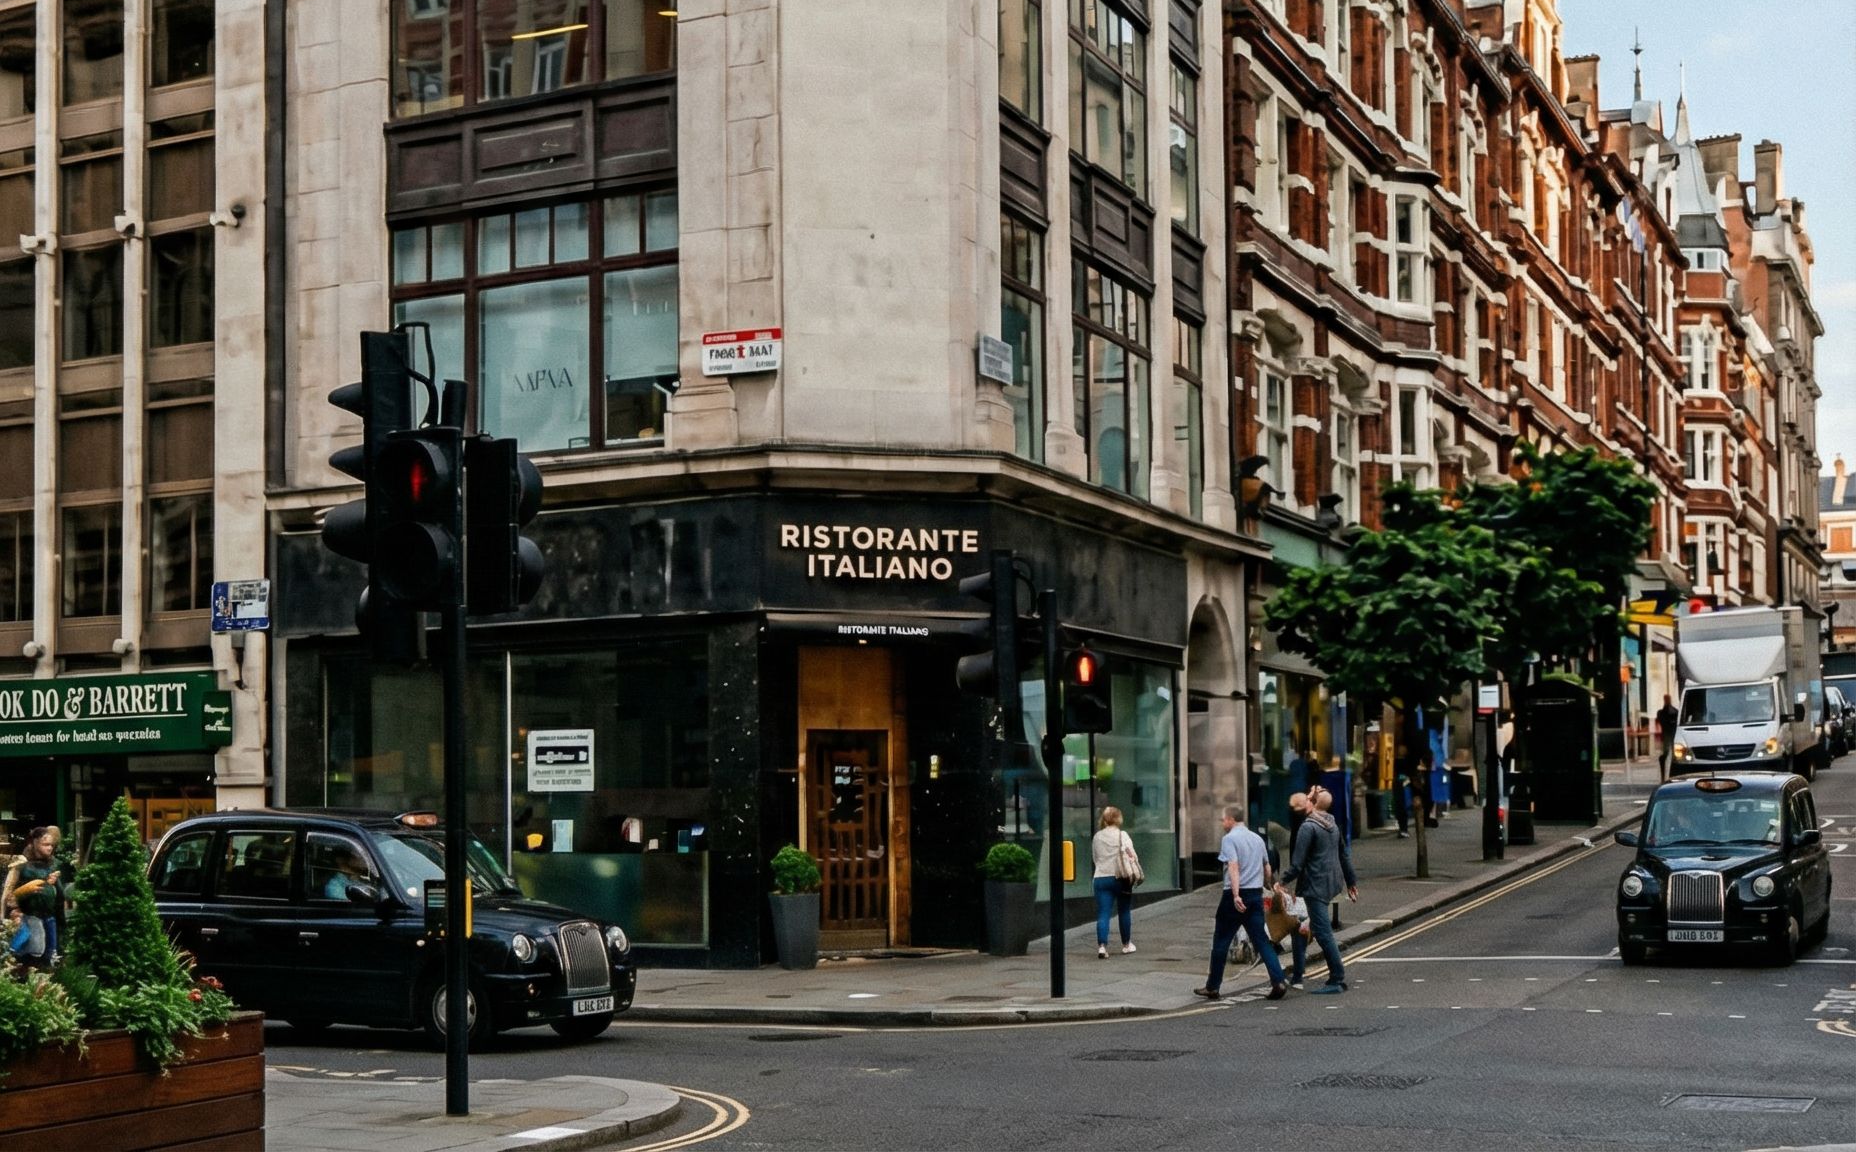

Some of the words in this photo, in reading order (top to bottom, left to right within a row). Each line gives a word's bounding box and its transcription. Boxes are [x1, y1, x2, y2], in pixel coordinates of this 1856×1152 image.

[781, 524, 978, 553] RISTORANTE
[808, 554, 953, 580] ITALIANO
[32, 688, 59, 717] DO
[64, 687, 84, 720] &
[89, 683, 187, 715] BARRETT
